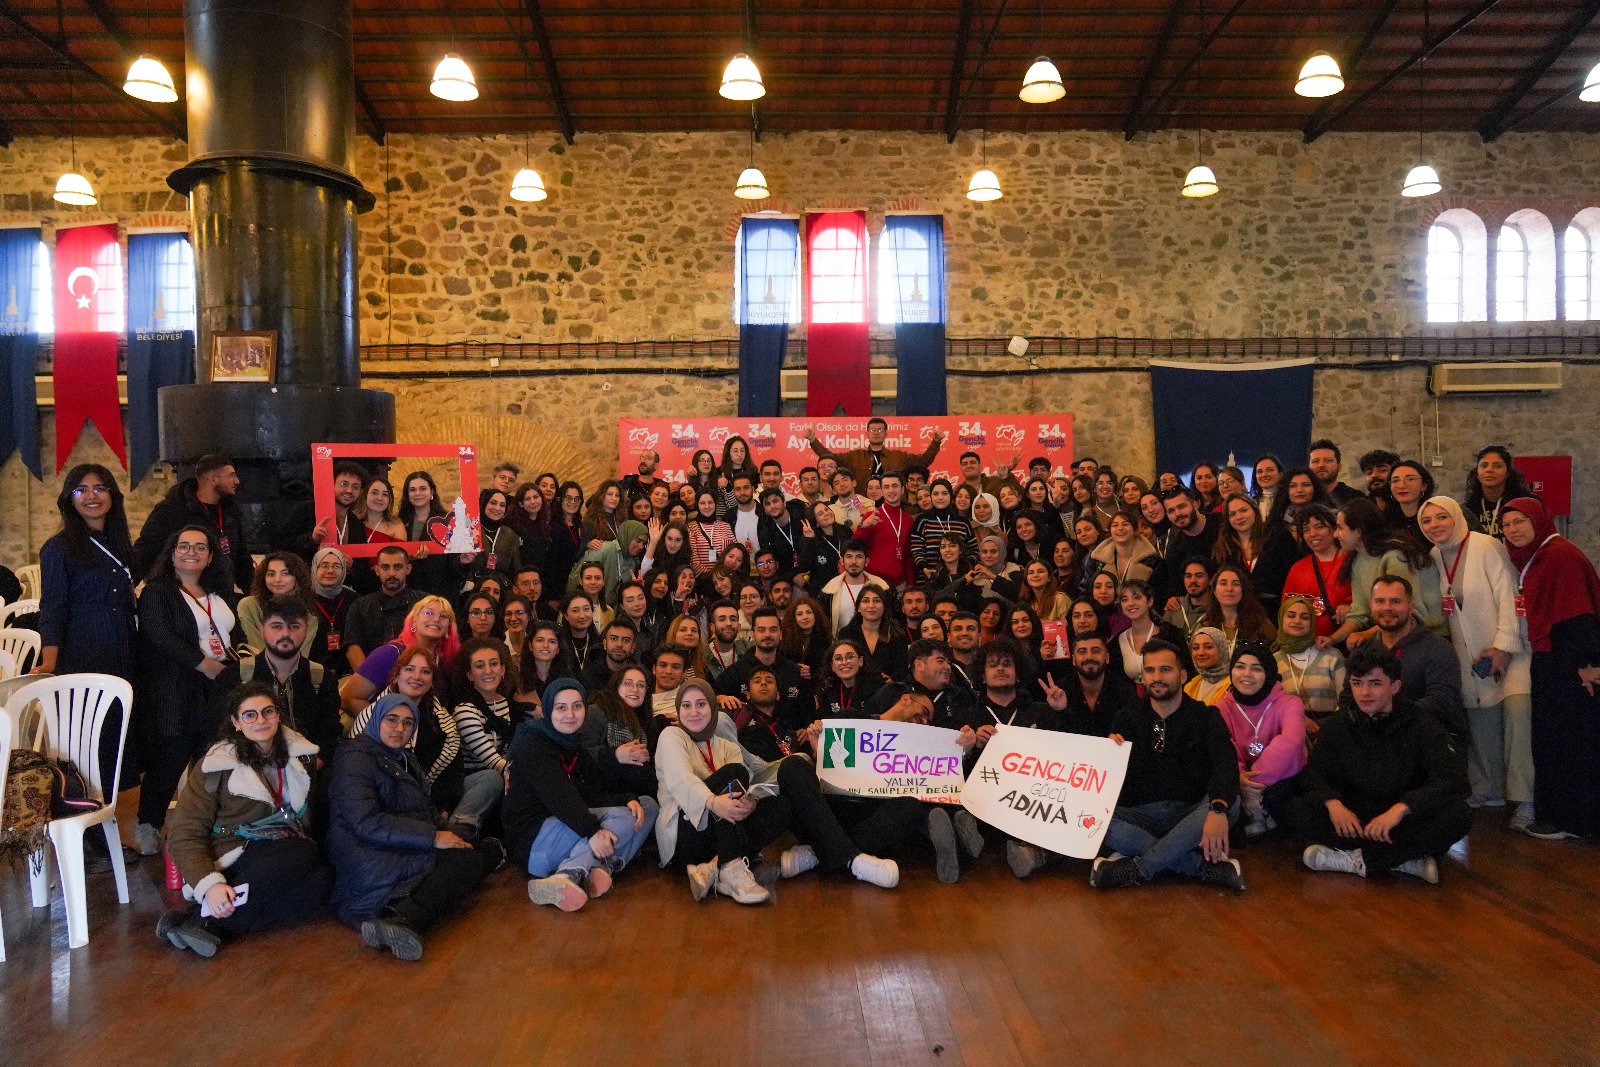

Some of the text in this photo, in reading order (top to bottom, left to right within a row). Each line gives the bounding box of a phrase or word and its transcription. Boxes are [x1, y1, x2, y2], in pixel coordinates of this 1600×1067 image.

[671, 424, 700, 438] 34.
[748, 423, 777, 438] 34.
[816, 422, 844, 432] Olsak
[845, 422, 858, 431] da
[958, 421, 987, 436] 34.
[1038, 423, 1066, 438] 34.
[859, 729, 899, 753] BİZ
[872, 752, 960, 776] GENÇLER
[1001, 752, 1107, 794] GENÇLİĞİN
[883, 777, 928, 787] YALNIZ
[925, 784, 962, 794] DEĞİL
[998, 790, 1068, 824] ADINA
